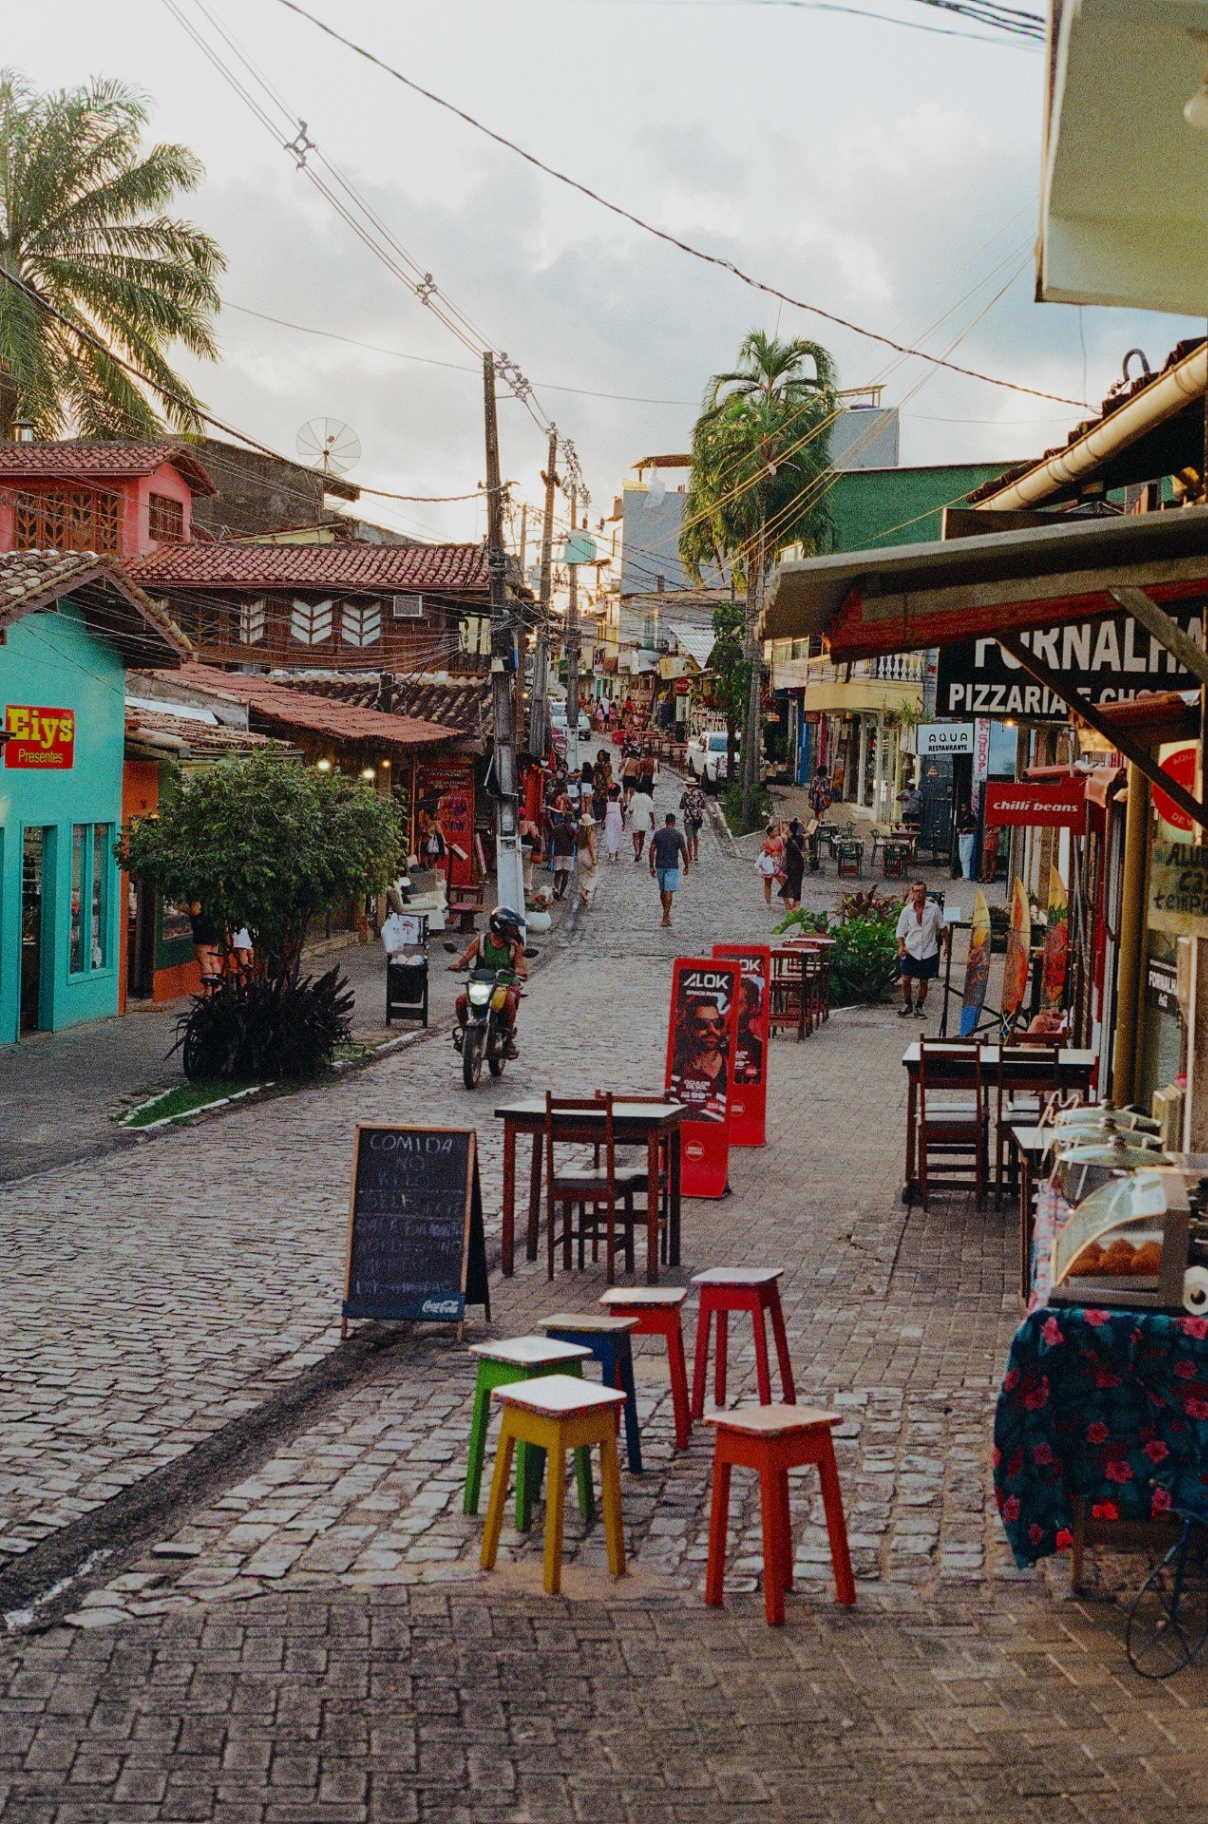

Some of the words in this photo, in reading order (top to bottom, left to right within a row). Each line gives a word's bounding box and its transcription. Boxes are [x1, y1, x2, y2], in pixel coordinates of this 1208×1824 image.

[948, 682, 1068, 715] PIZZARIA
[928, 732, 968, 743] AQUA
[928, 744, 967, 752] RESTAURANTE
[18, 748, 64, 764] Presentes
[993, 800, 1030, 811] chilli
[1032, 802, 1079, 812] beans
[1171, 812, 1186, 825] DE
[683, 973, 729, 990] ALOK
[369, 1134, 455, 1155] COMIDA
